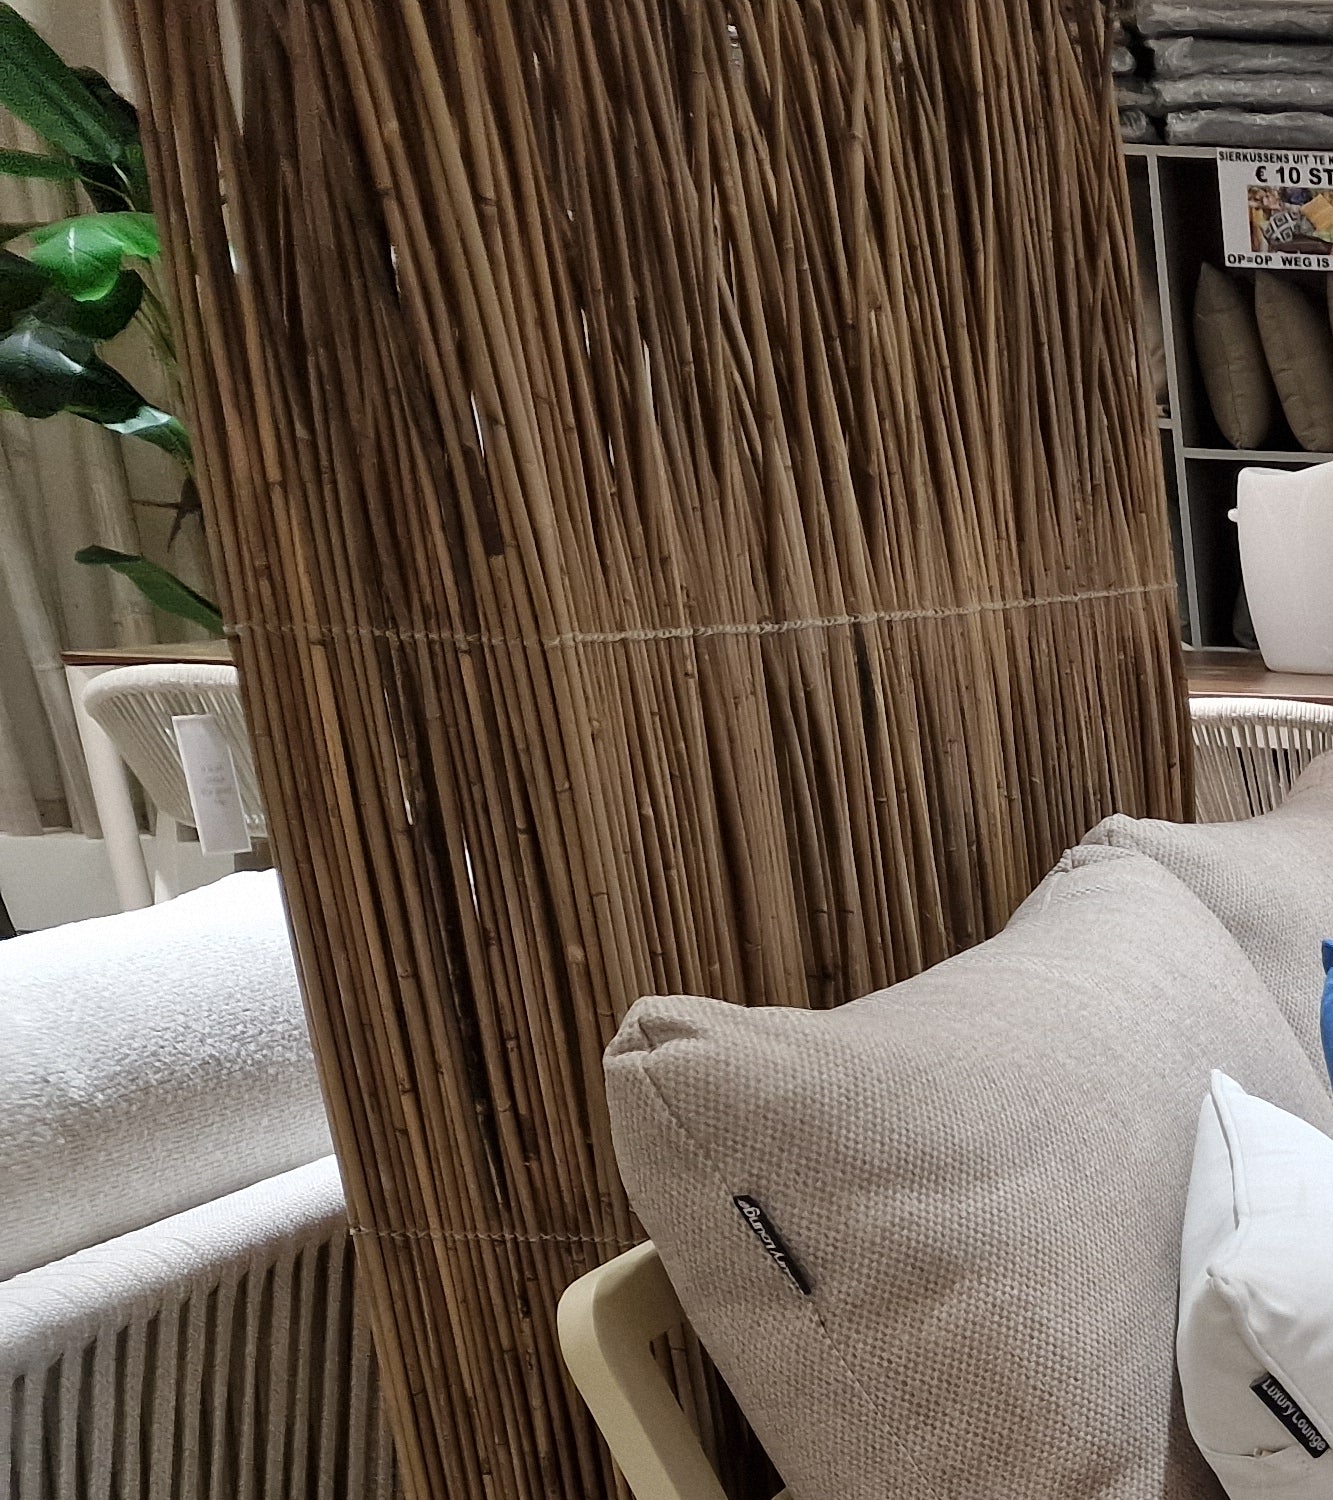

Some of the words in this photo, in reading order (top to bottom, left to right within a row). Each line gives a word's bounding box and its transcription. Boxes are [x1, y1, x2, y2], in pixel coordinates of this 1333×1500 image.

[1218, 151, 1290, 164] SIERKUSSENS
[1292, 154, 1309, 164] UIT
[1313, 155, 1326, 165] TE
[1255, 165, 1268, 183] €
[1276, 165, 1301, 184] 10
[1227, 254, 1273, 265] OP=OP
[1280, 255, 1312, 267] WEG
[1317, 257, 1330, 268] IS
[1261, 1378, 1296, 1416] Luxury
[1291, 1411, 1327, 1451] Lounge
